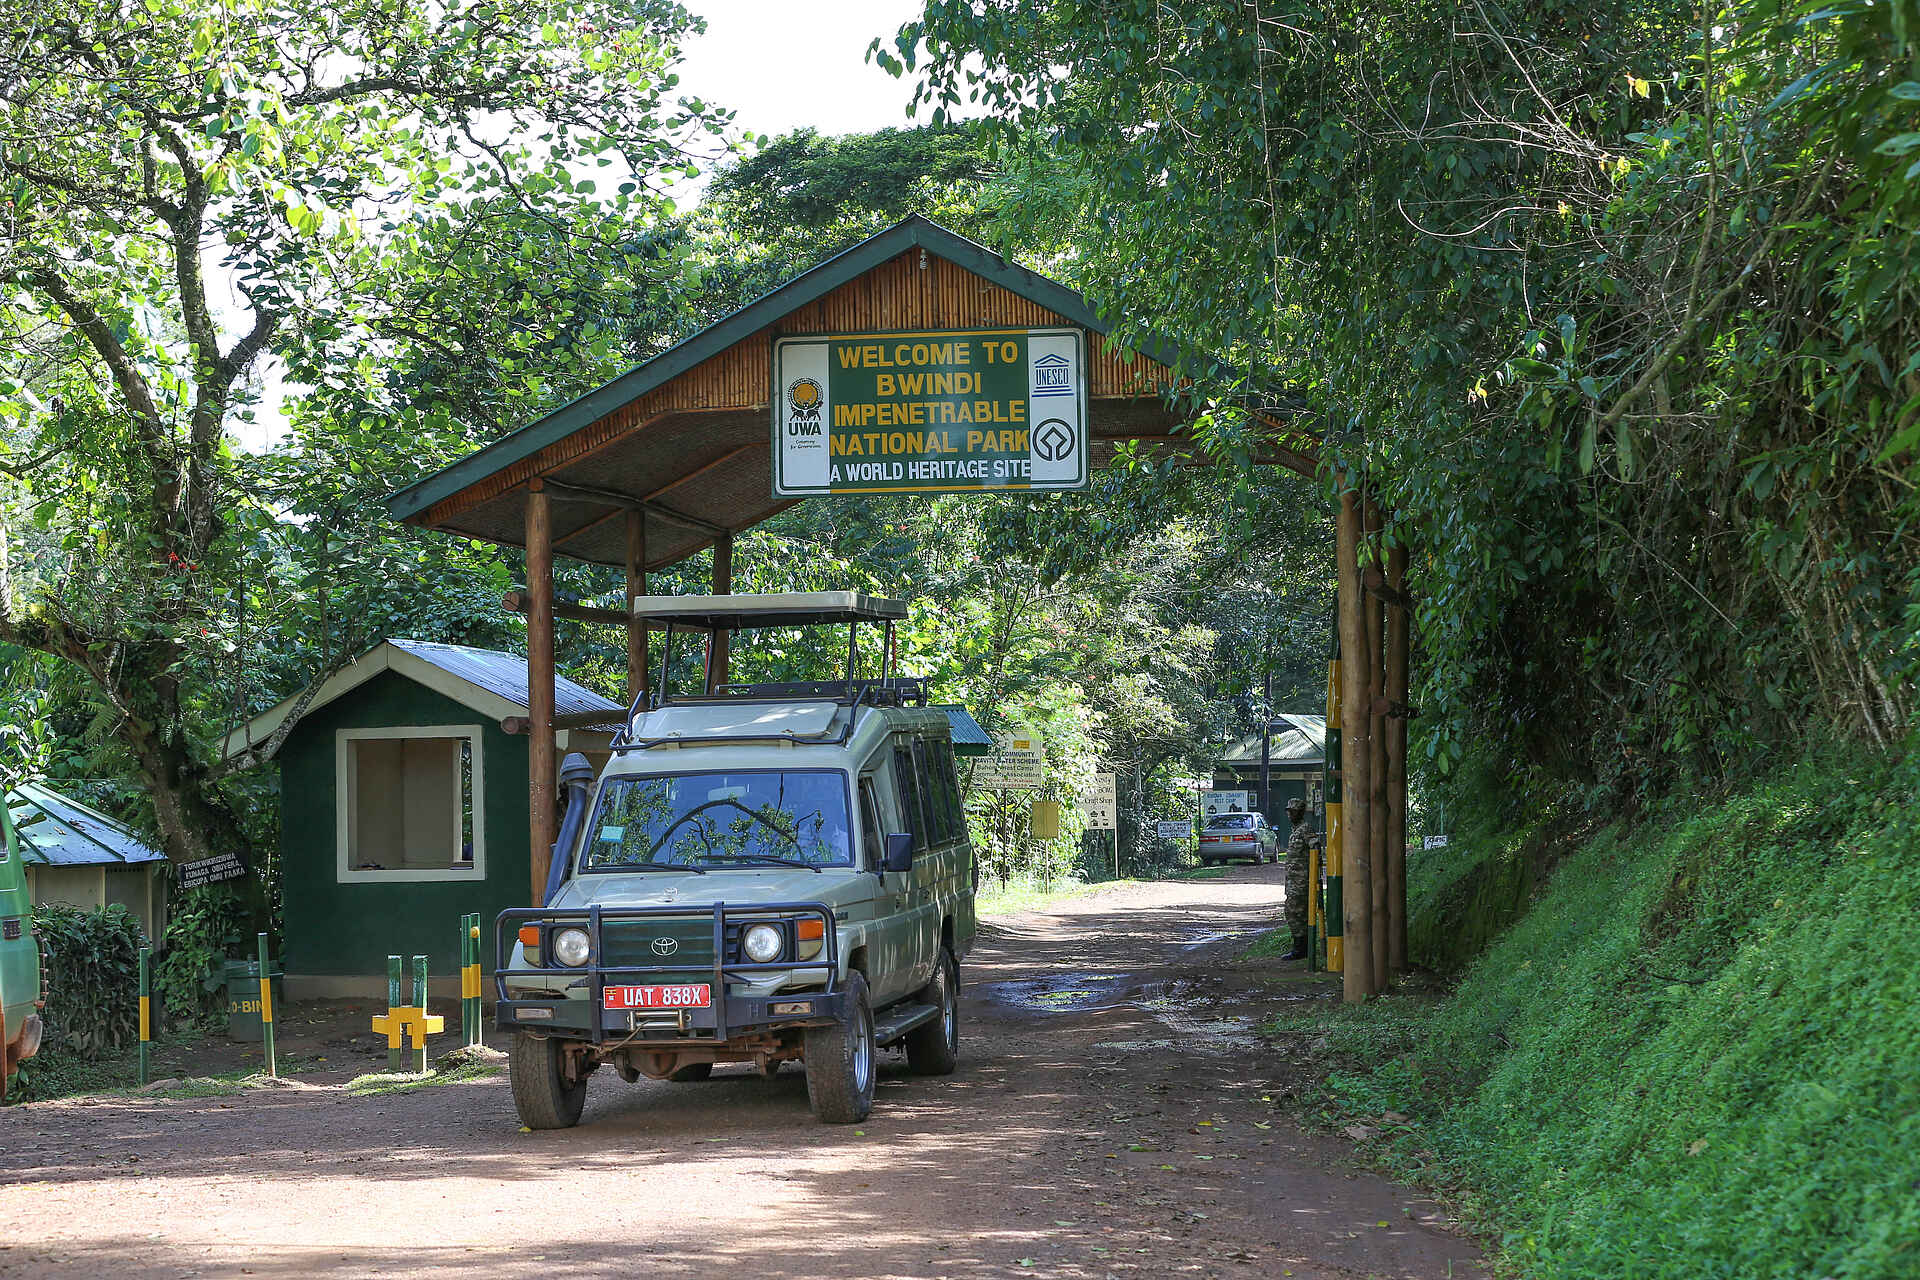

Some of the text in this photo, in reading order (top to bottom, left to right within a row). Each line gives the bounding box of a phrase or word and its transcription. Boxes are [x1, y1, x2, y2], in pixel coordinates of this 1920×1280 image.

[838, 341, 1018, 368] WELCOME TO
[876, 372, 982, 396] BWINDI
[1036, 368, 1069, 386] UNESCO
[834, 400, 1024, 426] IMPENETRABLE
[788, 422, 822, 436] UWA
[829, 431, 958, 456] NATIONAL
[967, 430, 1030, 453] PARK
[830, 459, 1032, 482] A WORLD HERITAGE SITE
[663, 987, 702, 1005] 838X
